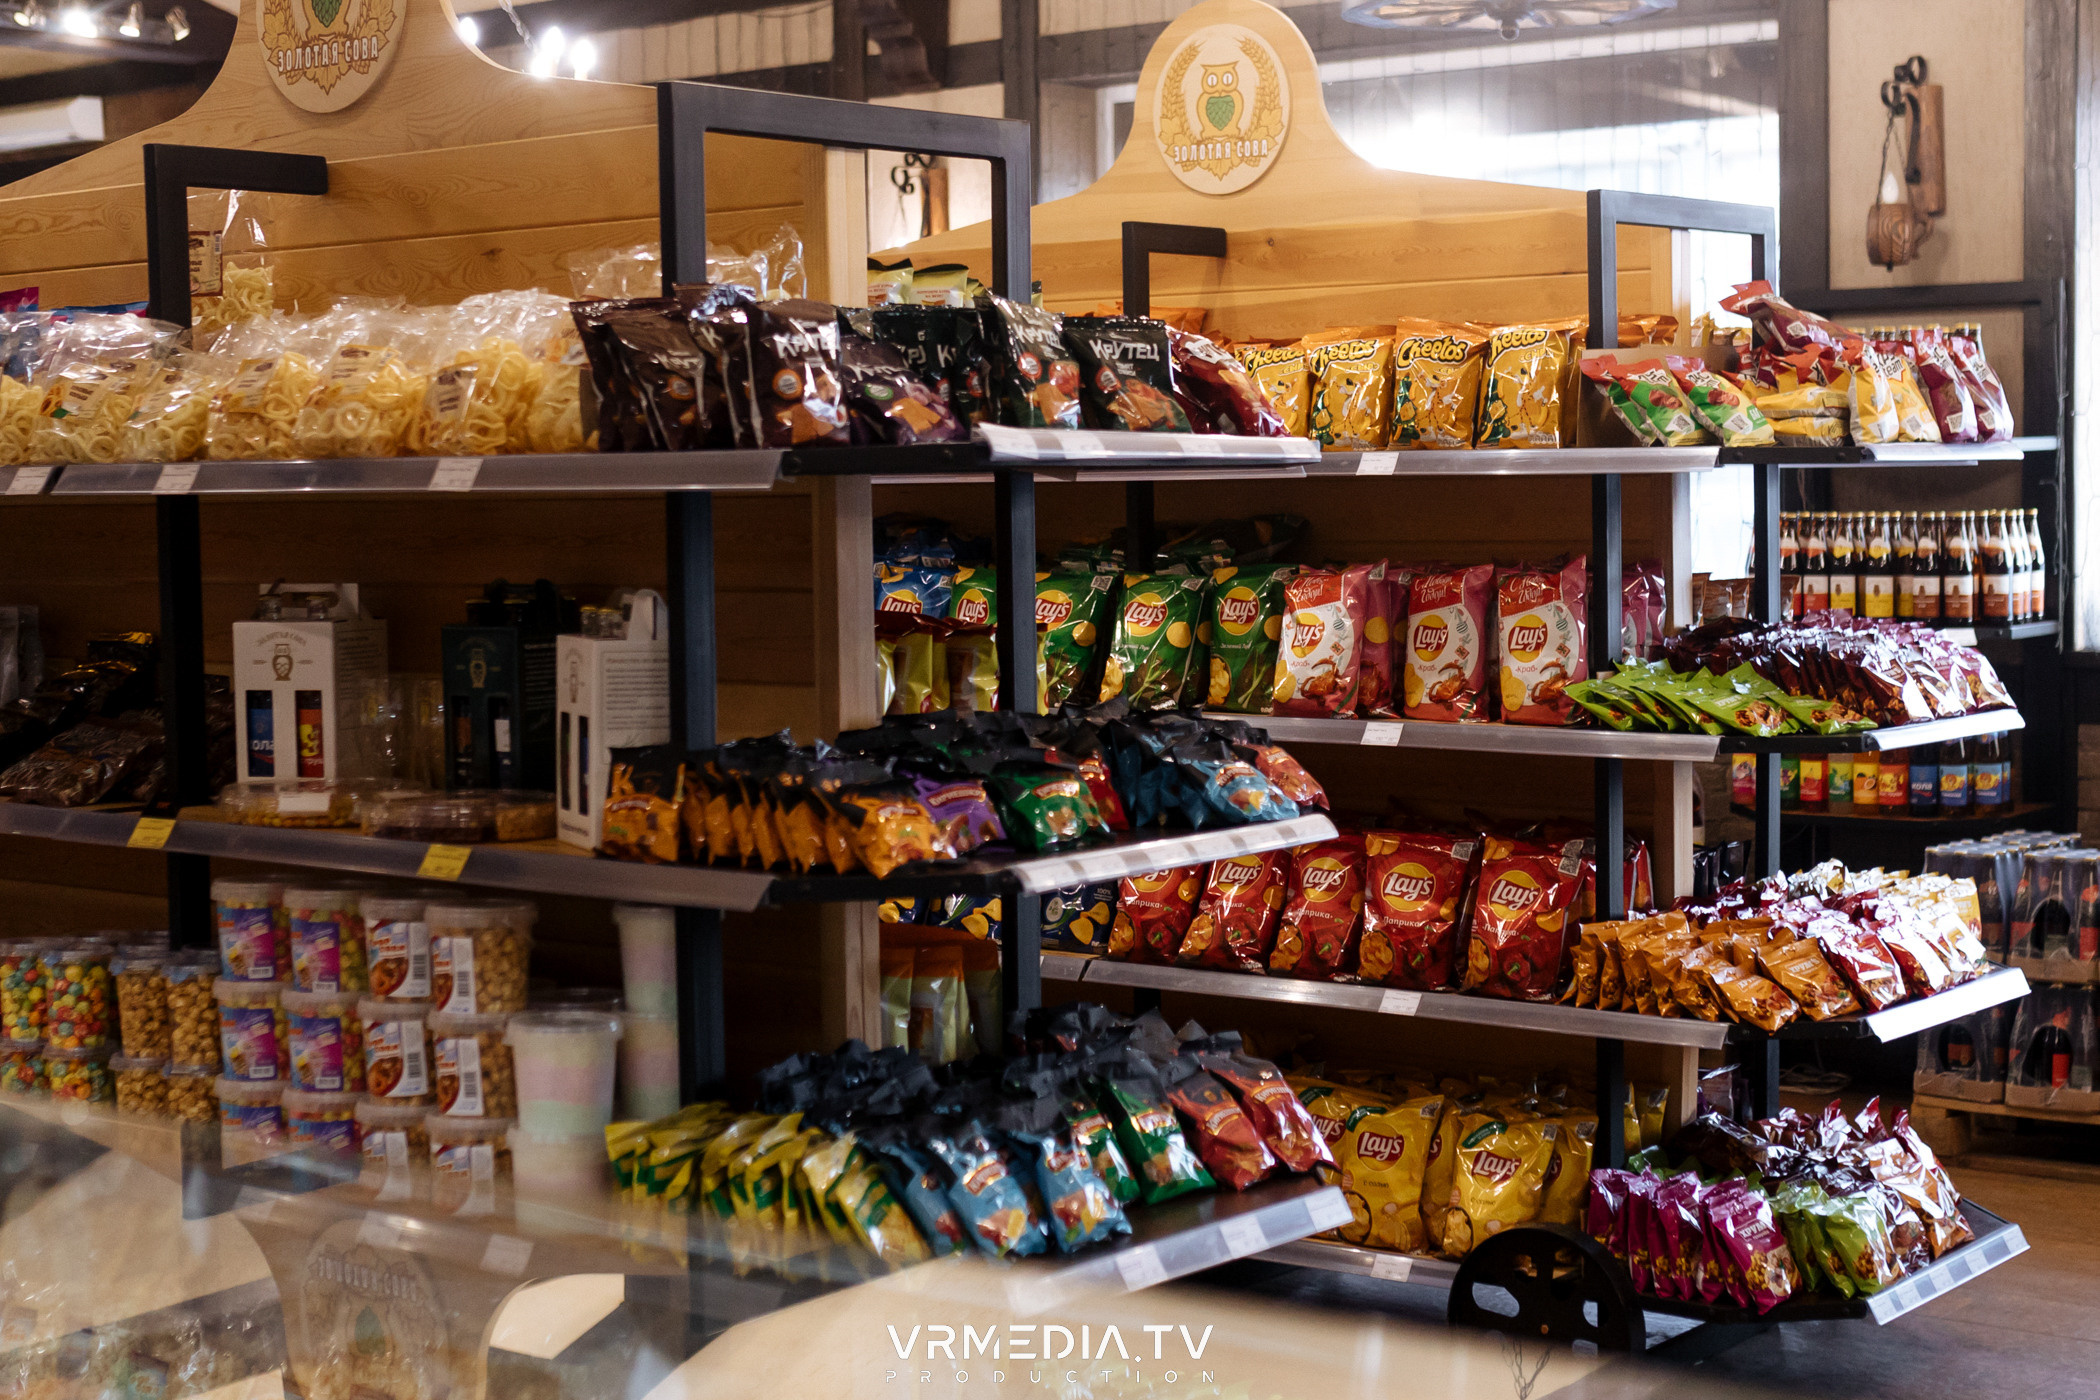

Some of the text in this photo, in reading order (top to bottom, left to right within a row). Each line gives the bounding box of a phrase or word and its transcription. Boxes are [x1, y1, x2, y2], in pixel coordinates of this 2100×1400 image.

[277, 35, 379, 72] ЗОЛОТАЯ СОВА
[1174, 139, 1268, 162] ЗОЛОТАЯ СОВА
[1090, 339, 1160, 362] КРУТЕЦ
[1310, 339, 1377, 376] Cheetos
[1398, 336, 1468, 368] Cheetos
[1487, 330, 1547, 367] heetos
[957, 598, 987, 622] Lay's
[1125, 601, 1166, 628] Lay's
[1221, 598, 1257, 625] Lay's
[1415, 624, 1448, 652] Lay's
[1510, 625, 1546, 653] Lay's
[1218, 863, 1262, 886] Lay's
[1303, 872, 1342, 898] Lay's
[1384, 873, 1433, 902] Lay's
[1131, 899, 1160, 910] априка
[1491, 879, 1539, 912] Lay's
[1384, 916, 1421, 928] Паприка
[1359, 1131, 1401, 1162] Lay's
[1473, 1151, 1520, 1182] Lay's
